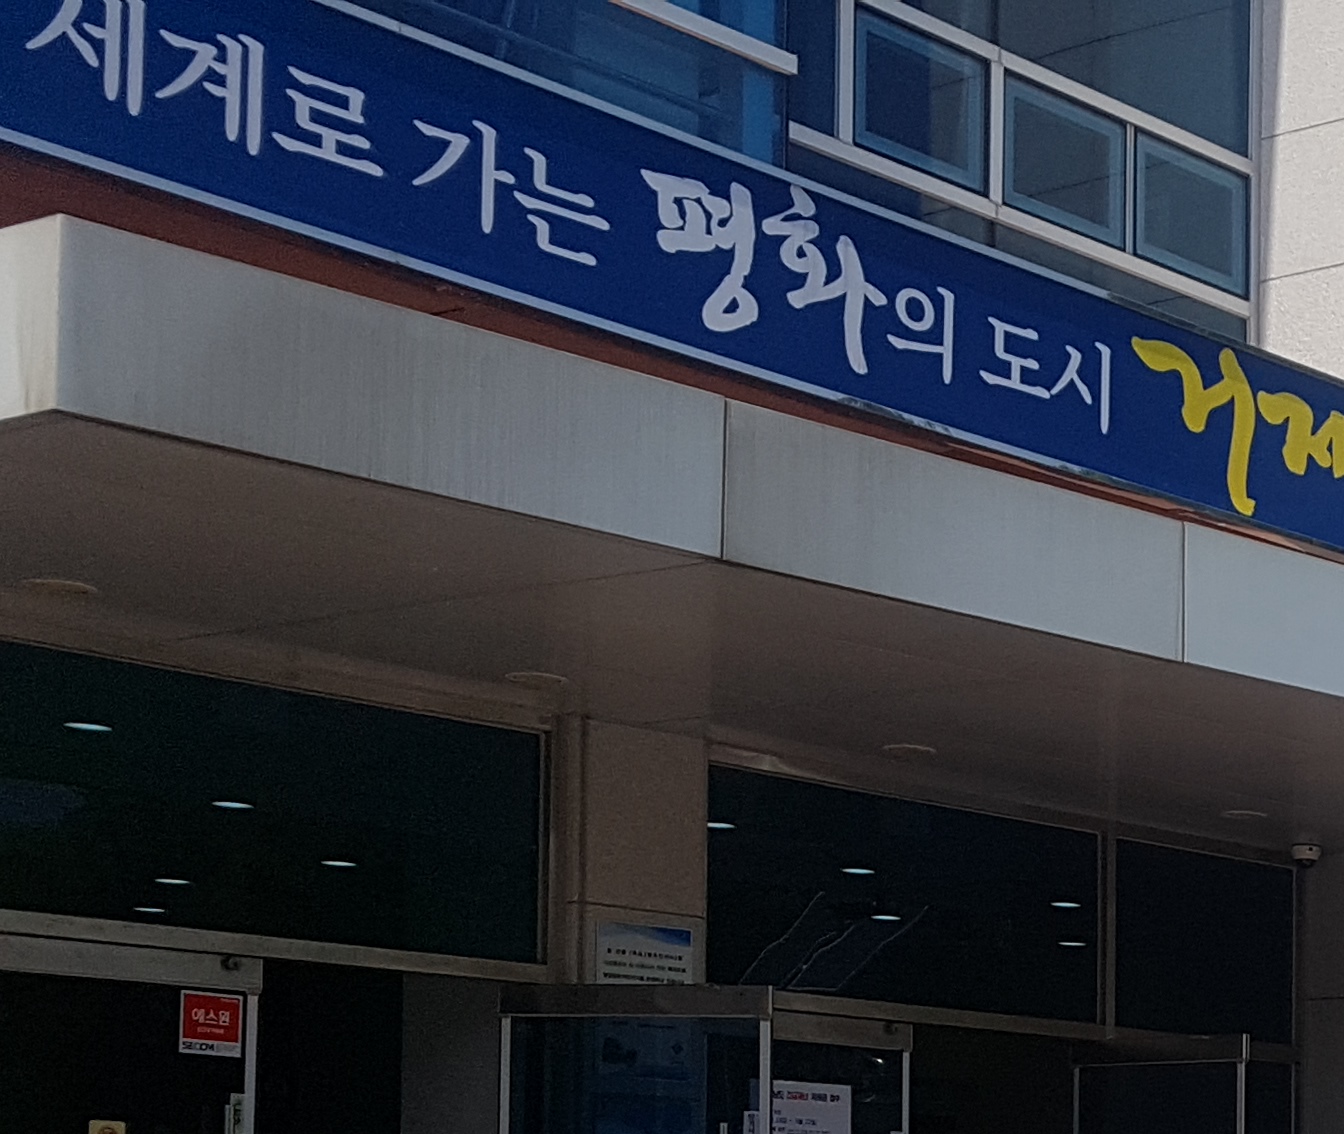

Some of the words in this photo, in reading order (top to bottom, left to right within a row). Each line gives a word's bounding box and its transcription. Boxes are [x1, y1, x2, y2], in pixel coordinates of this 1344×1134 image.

[27, 0, 385, 177] 세계로
[411, 119, 610, 266] 가는
[640, 168, 955, 385] 평화의
[979, 317, 1111, 434] 도시
[191, 1008, 231, 1026] 에스원
